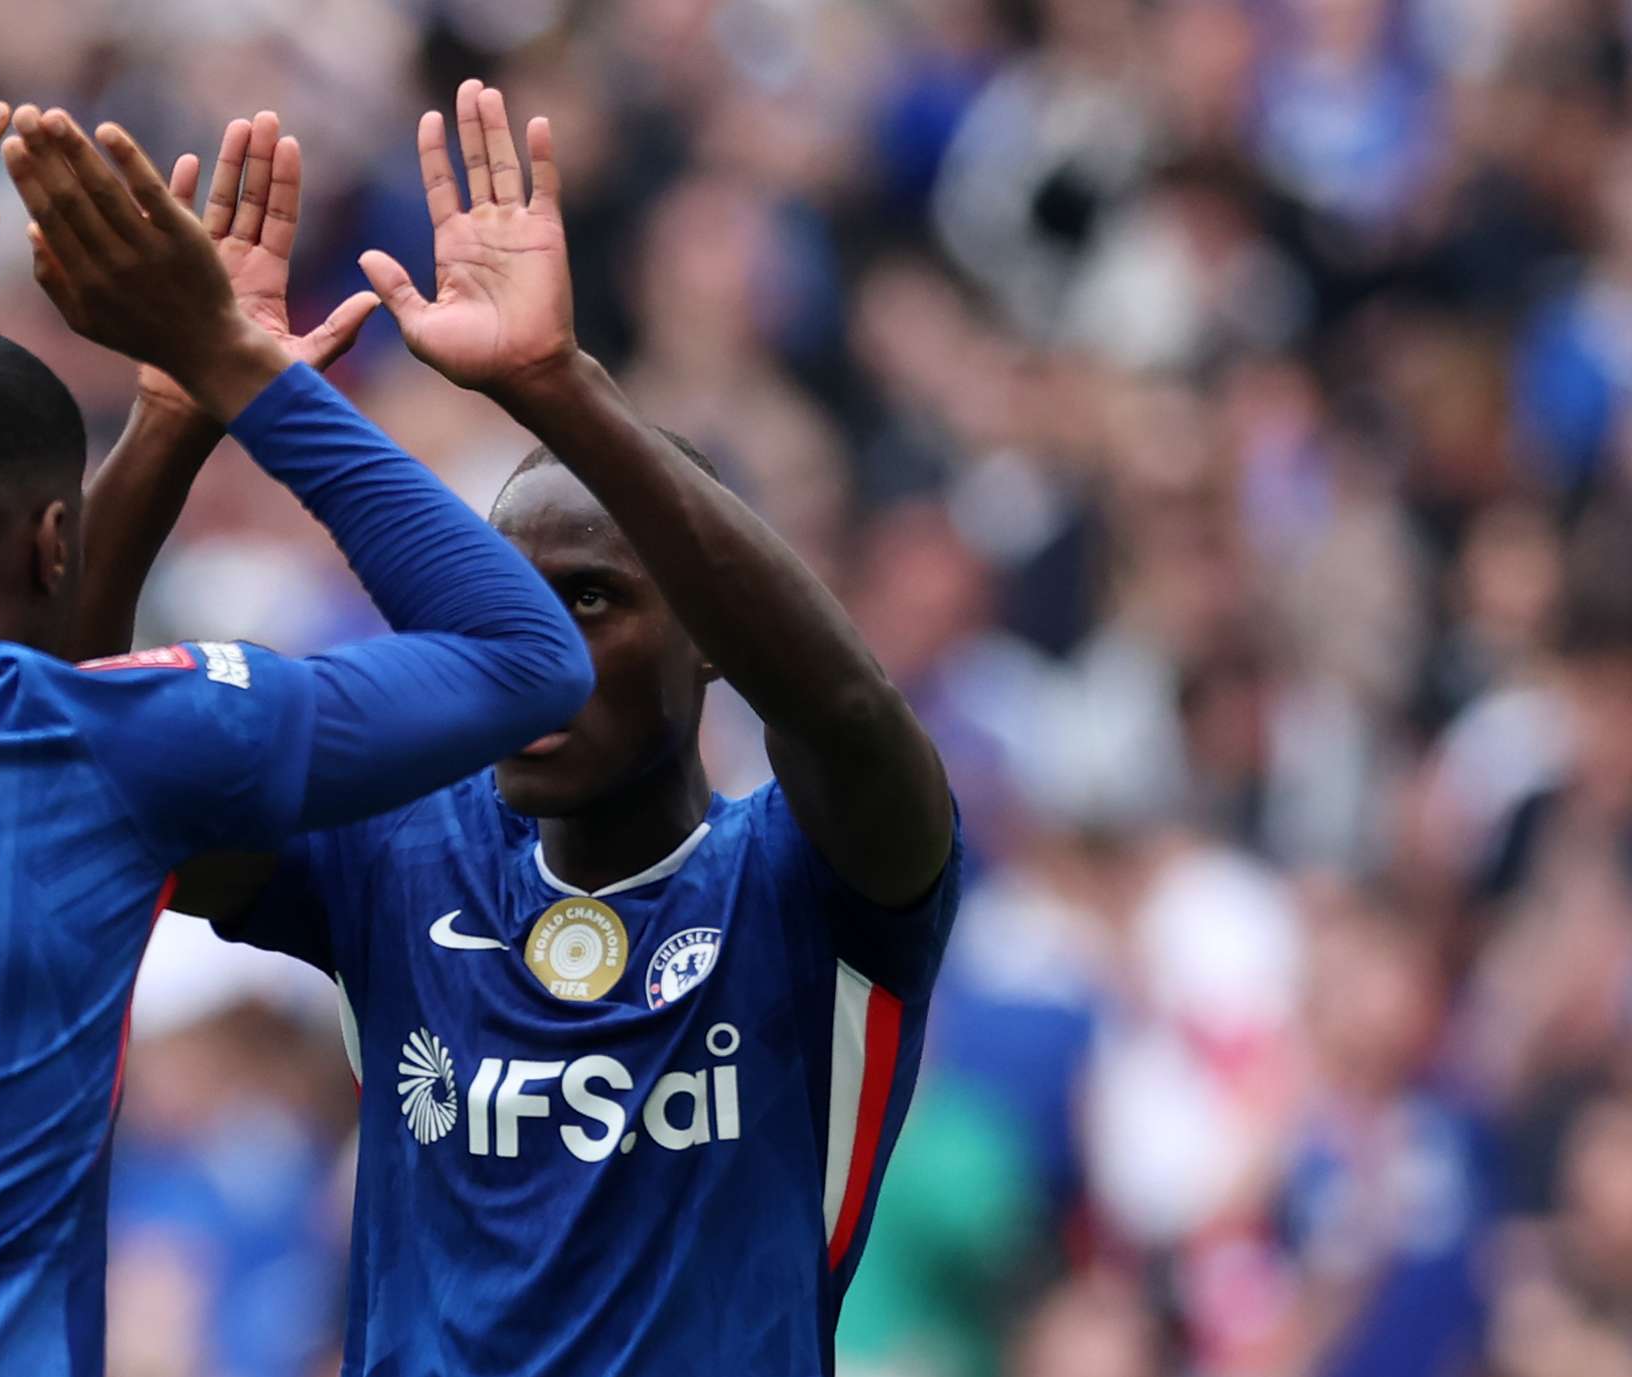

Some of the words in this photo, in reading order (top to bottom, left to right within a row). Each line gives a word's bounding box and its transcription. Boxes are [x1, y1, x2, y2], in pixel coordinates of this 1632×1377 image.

[533, 913, 564, 963] WORLD
[565, 906, 621, 968] CHAMPIONS
[653, 932, 713, 972] CHELSEA
[549, 980, 589, 997] FIFA
[467, 1021, 742, 1163] IFS.ai
